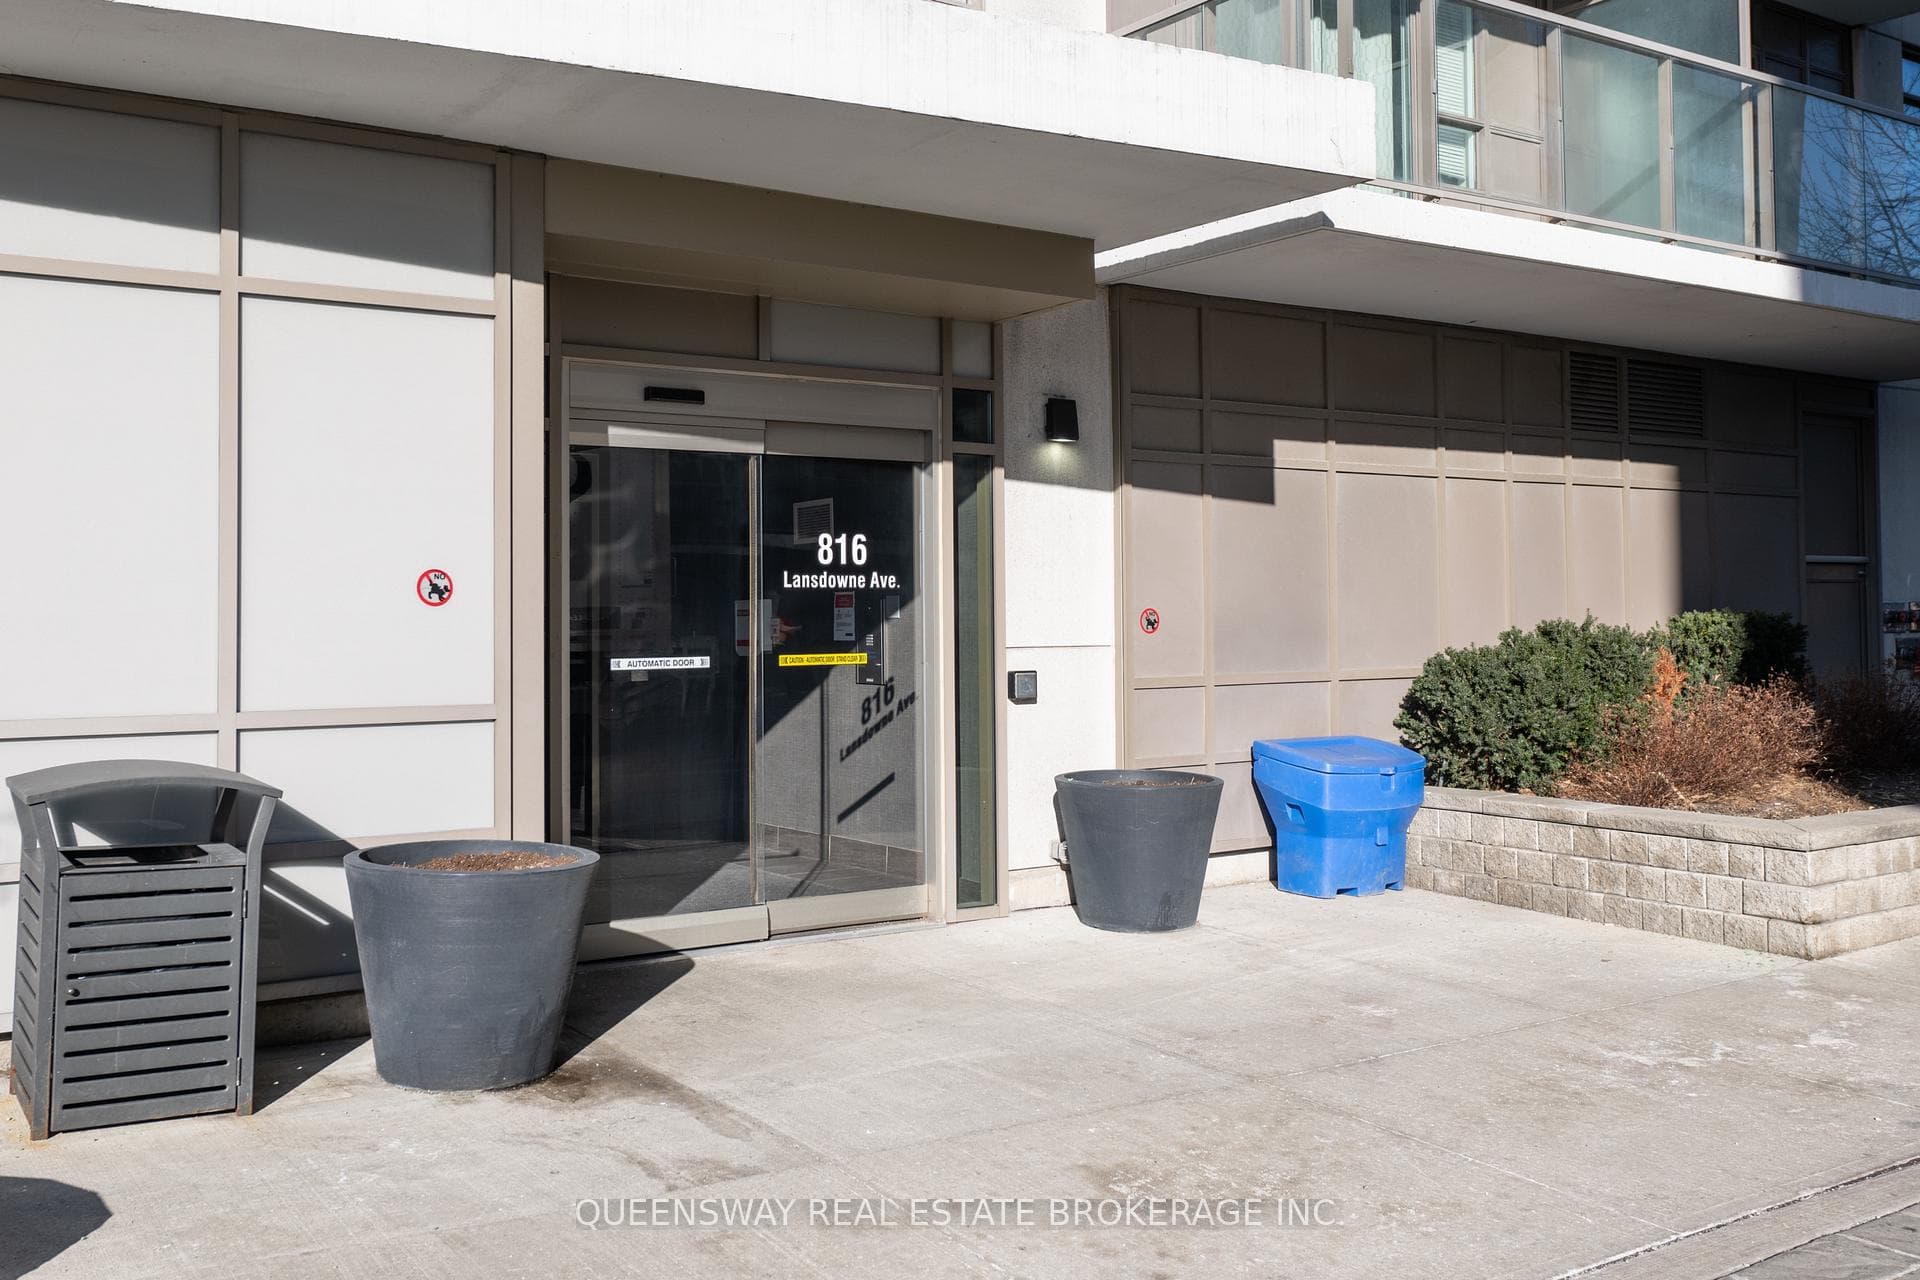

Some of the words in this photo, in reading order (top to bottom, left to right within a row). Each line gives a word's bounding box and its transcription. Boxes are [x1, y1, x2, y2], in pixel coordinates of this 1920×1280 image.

[817, 533, 868, 565] 816
[783, 571, 866, 588] Lansdowne
[870, 571, 901, 588] Ave.
[627, 659, 671, 668] AUTOMATIC
[672, 659, 695, 667] DOOR
